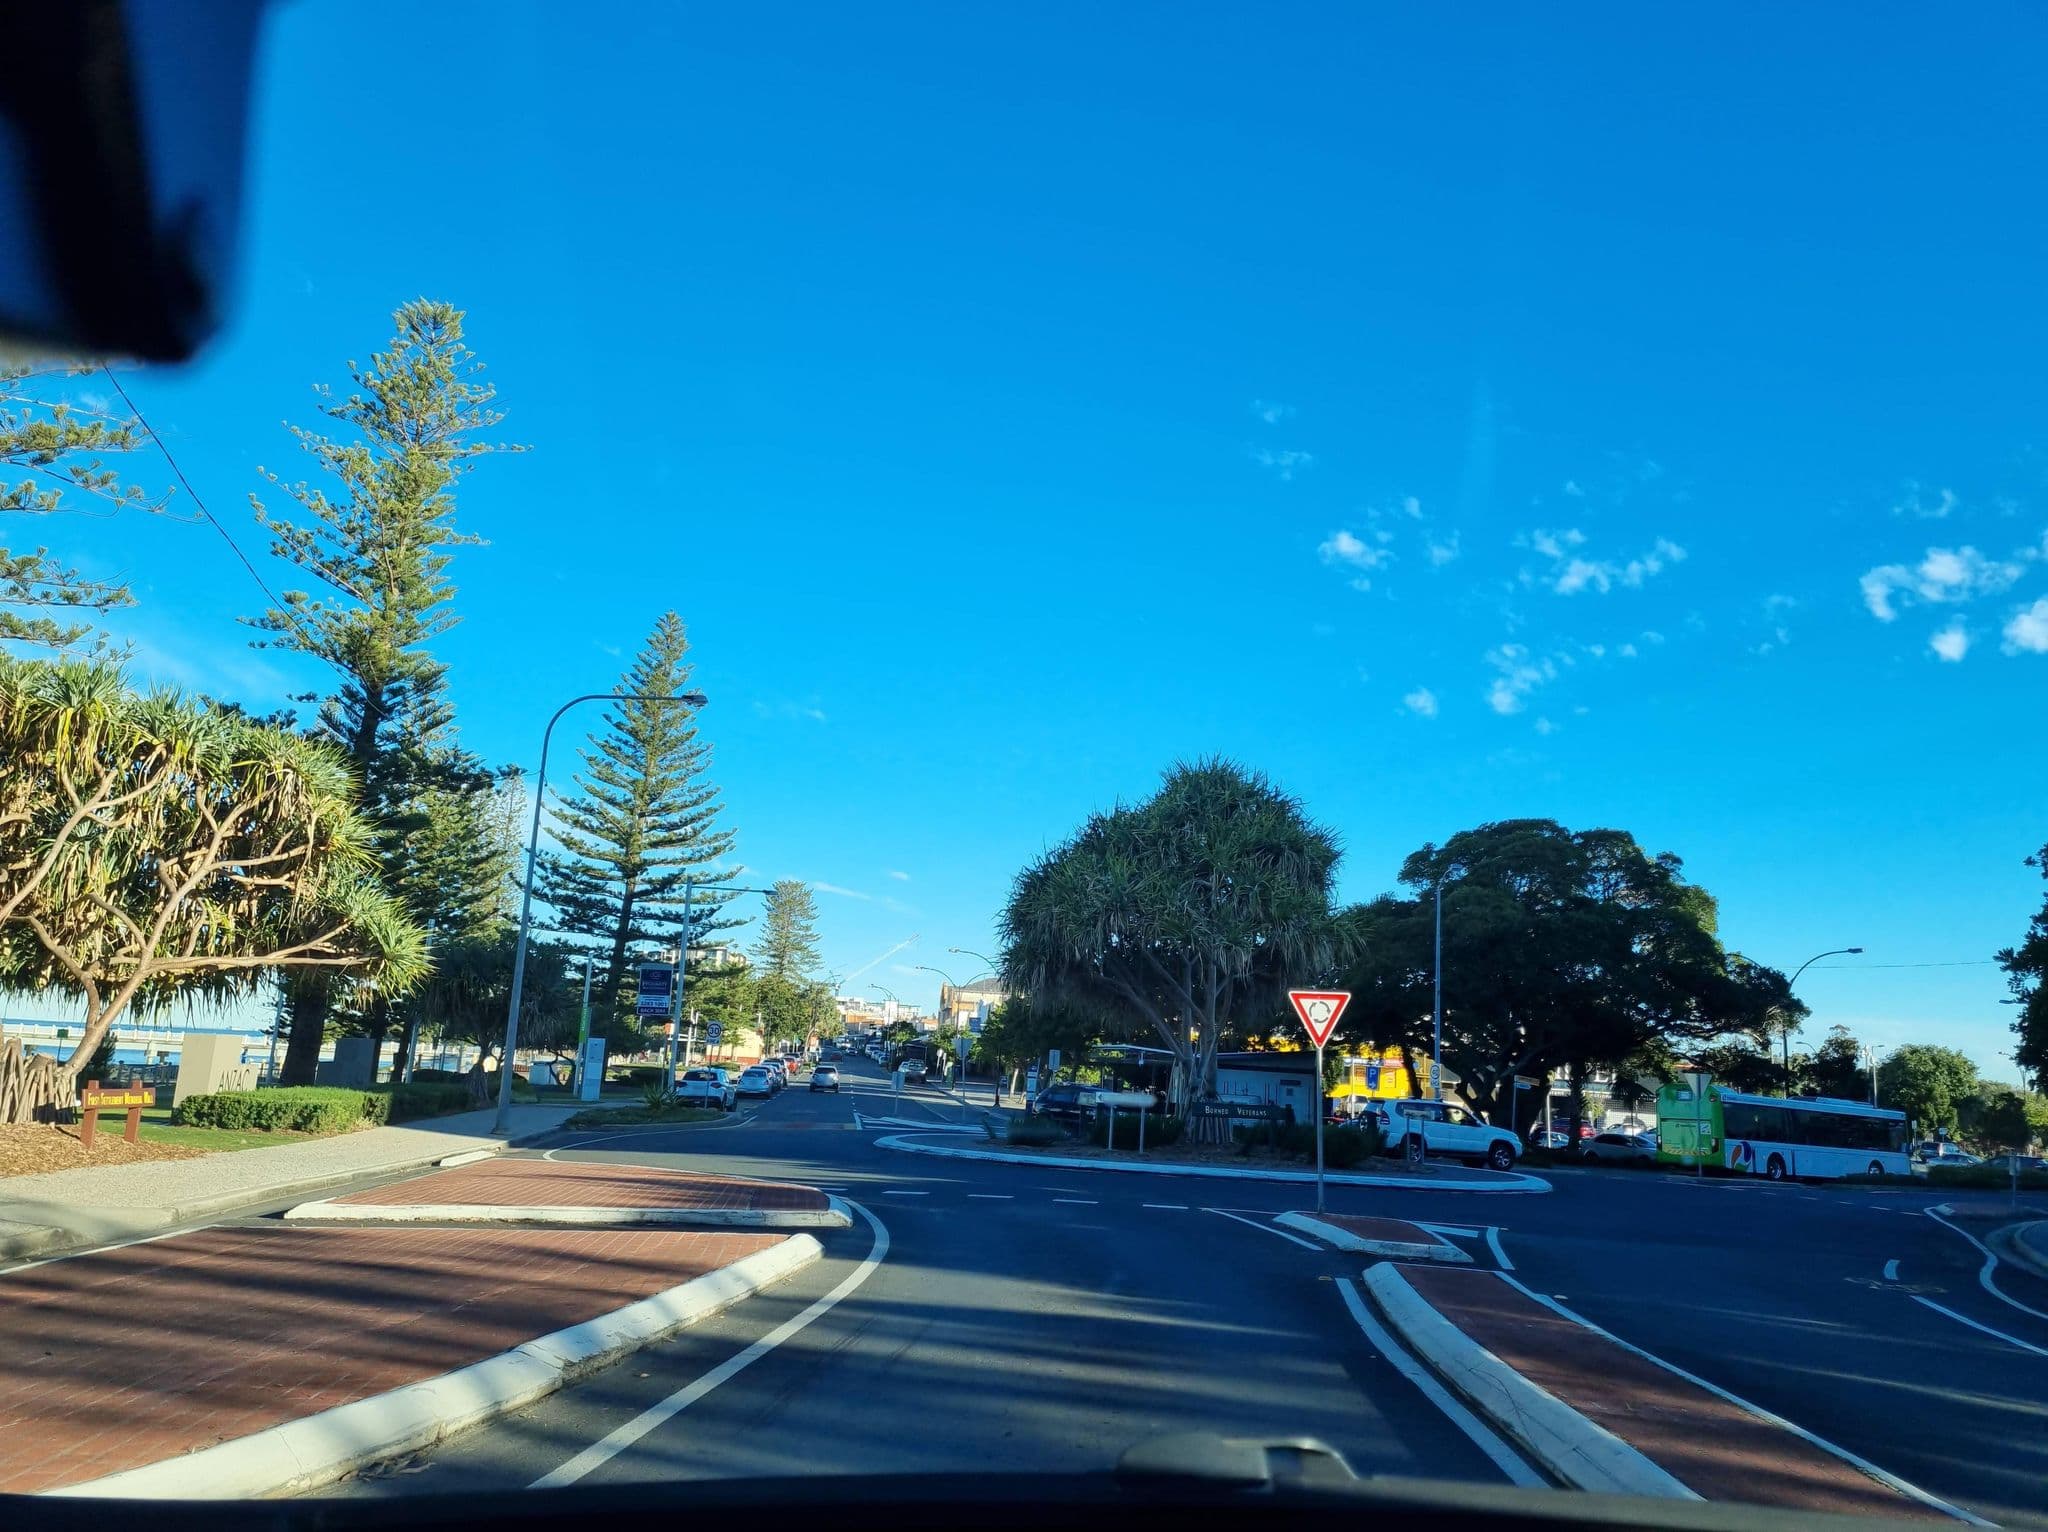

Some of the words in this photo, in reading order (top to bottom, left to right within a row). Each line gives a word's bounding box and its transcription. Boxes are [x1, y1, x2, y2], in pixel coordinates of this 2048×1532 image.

[218, 1068, 250, 1092] ANZAC
[1205, 1105, 1229, 1115] BORNEO
[1237, 1107, 1268, 1117] VETERANS
